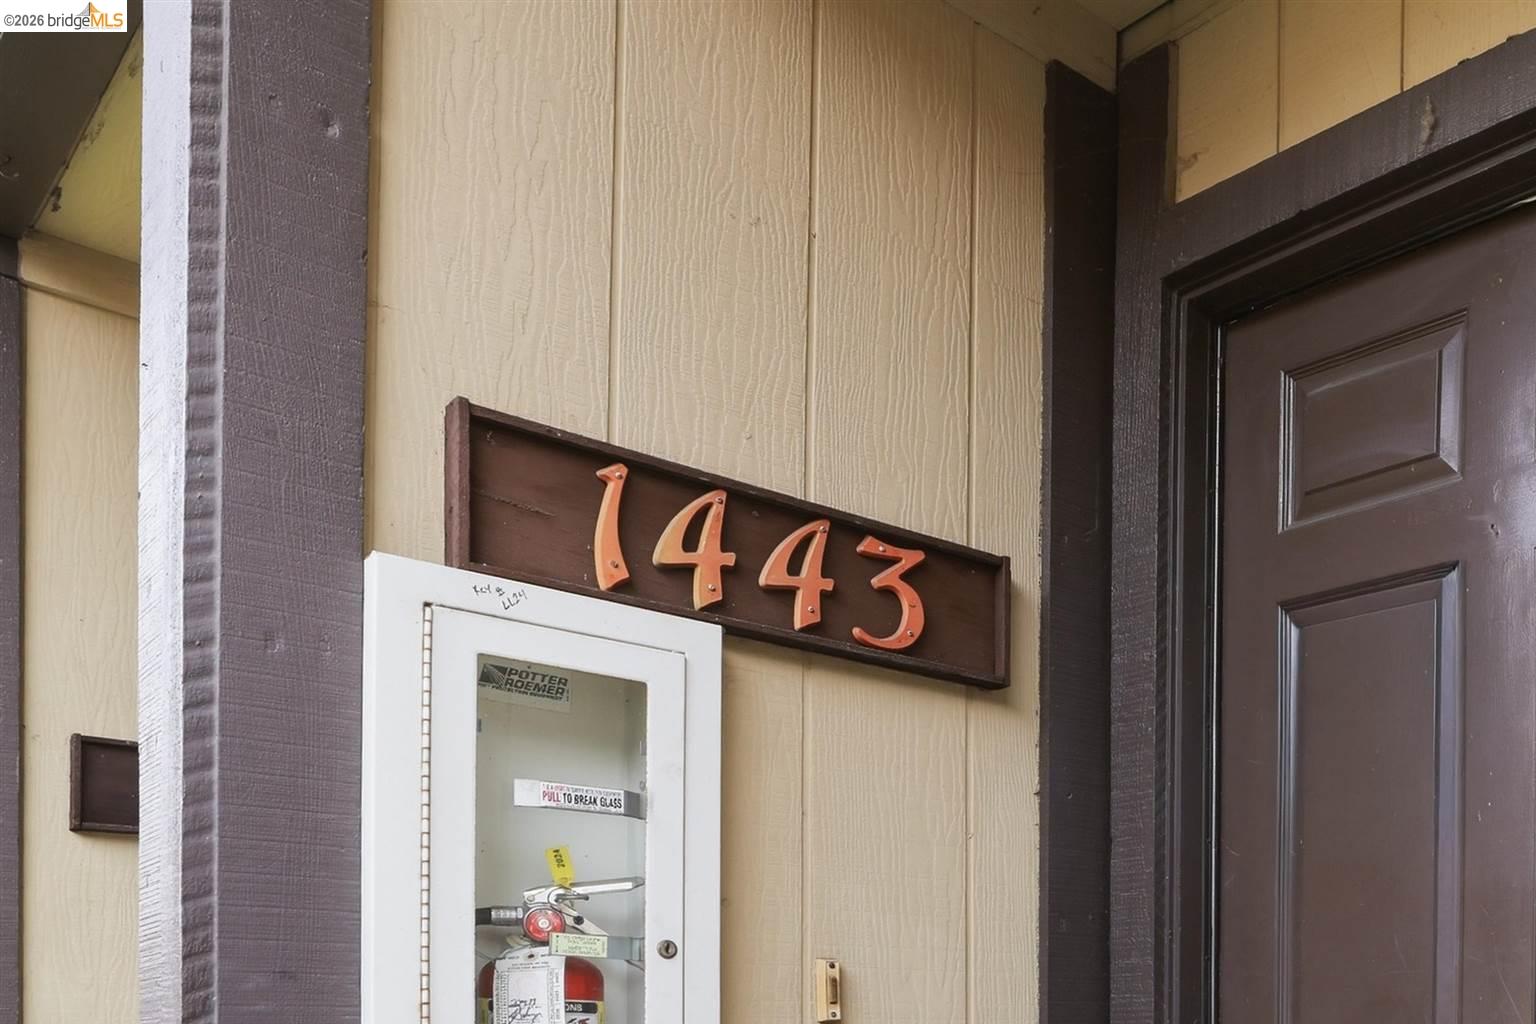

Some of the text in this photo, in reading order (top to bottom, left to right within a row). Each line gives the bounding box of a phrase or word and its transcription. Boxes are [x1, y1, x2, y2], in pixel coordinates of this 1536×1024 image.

[593, 462, 926, 651] 1443
[507, 666, 569, 687] POTTER
[504, 677, 566, 697] ROEMER
[542, 790, 561, 802] PULL
[563, 792, 573, 804] TO
[574, 794, 598, 806] BREAK
[600, 796, 622, 809] GLASS
